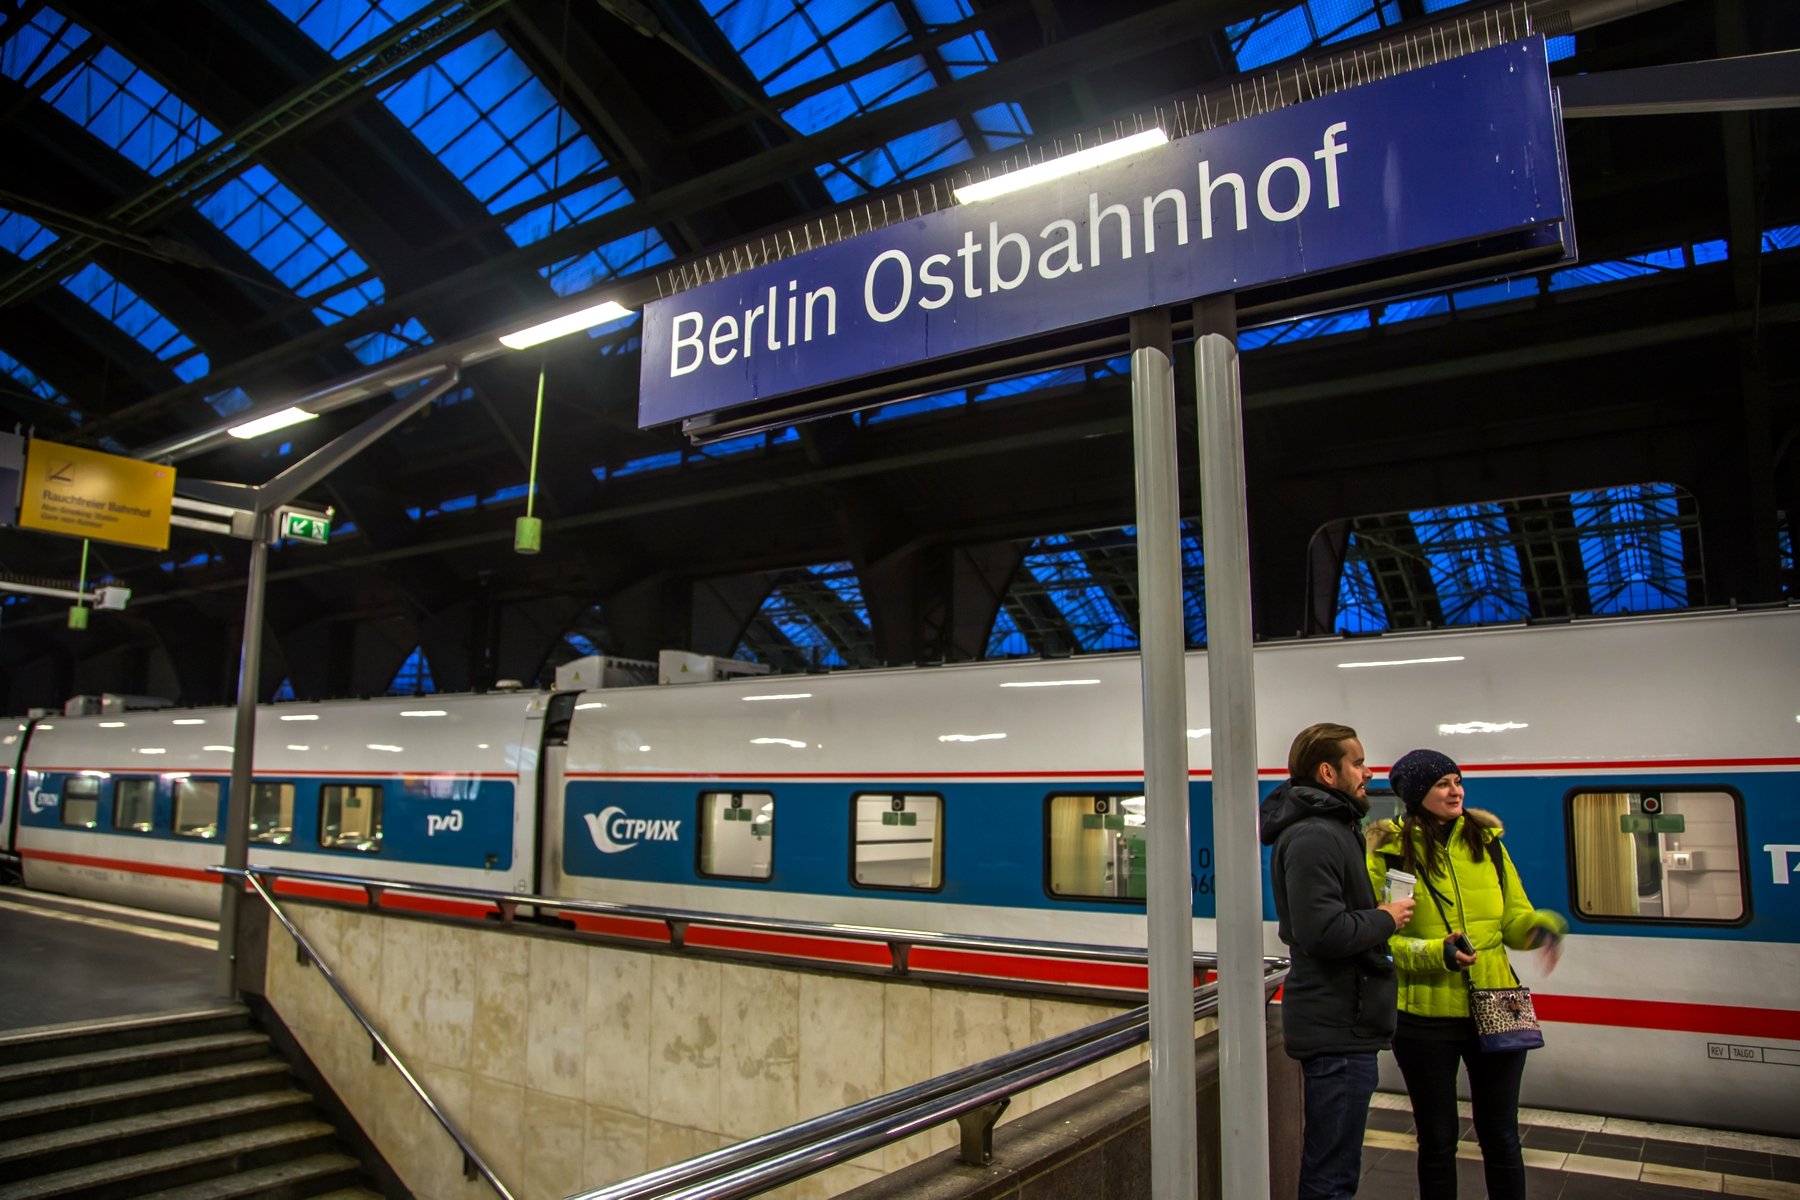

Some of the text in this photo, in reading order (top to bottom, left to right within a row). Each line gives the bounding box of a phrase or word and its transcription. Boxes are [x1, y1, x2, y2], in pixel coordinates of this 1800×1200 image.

[669, 121, 1350, 378] Berlin Ostbahnhof
[42, 489, 151, 518] Rauchfreier Bahnhof
[611, 818, 681, 841] СТРИЖ
[1763, 844, 1800, 884] T
[1711, 1046, 1724, 1056] REV
[1733, 1048, 1755, 1059] TALGO
